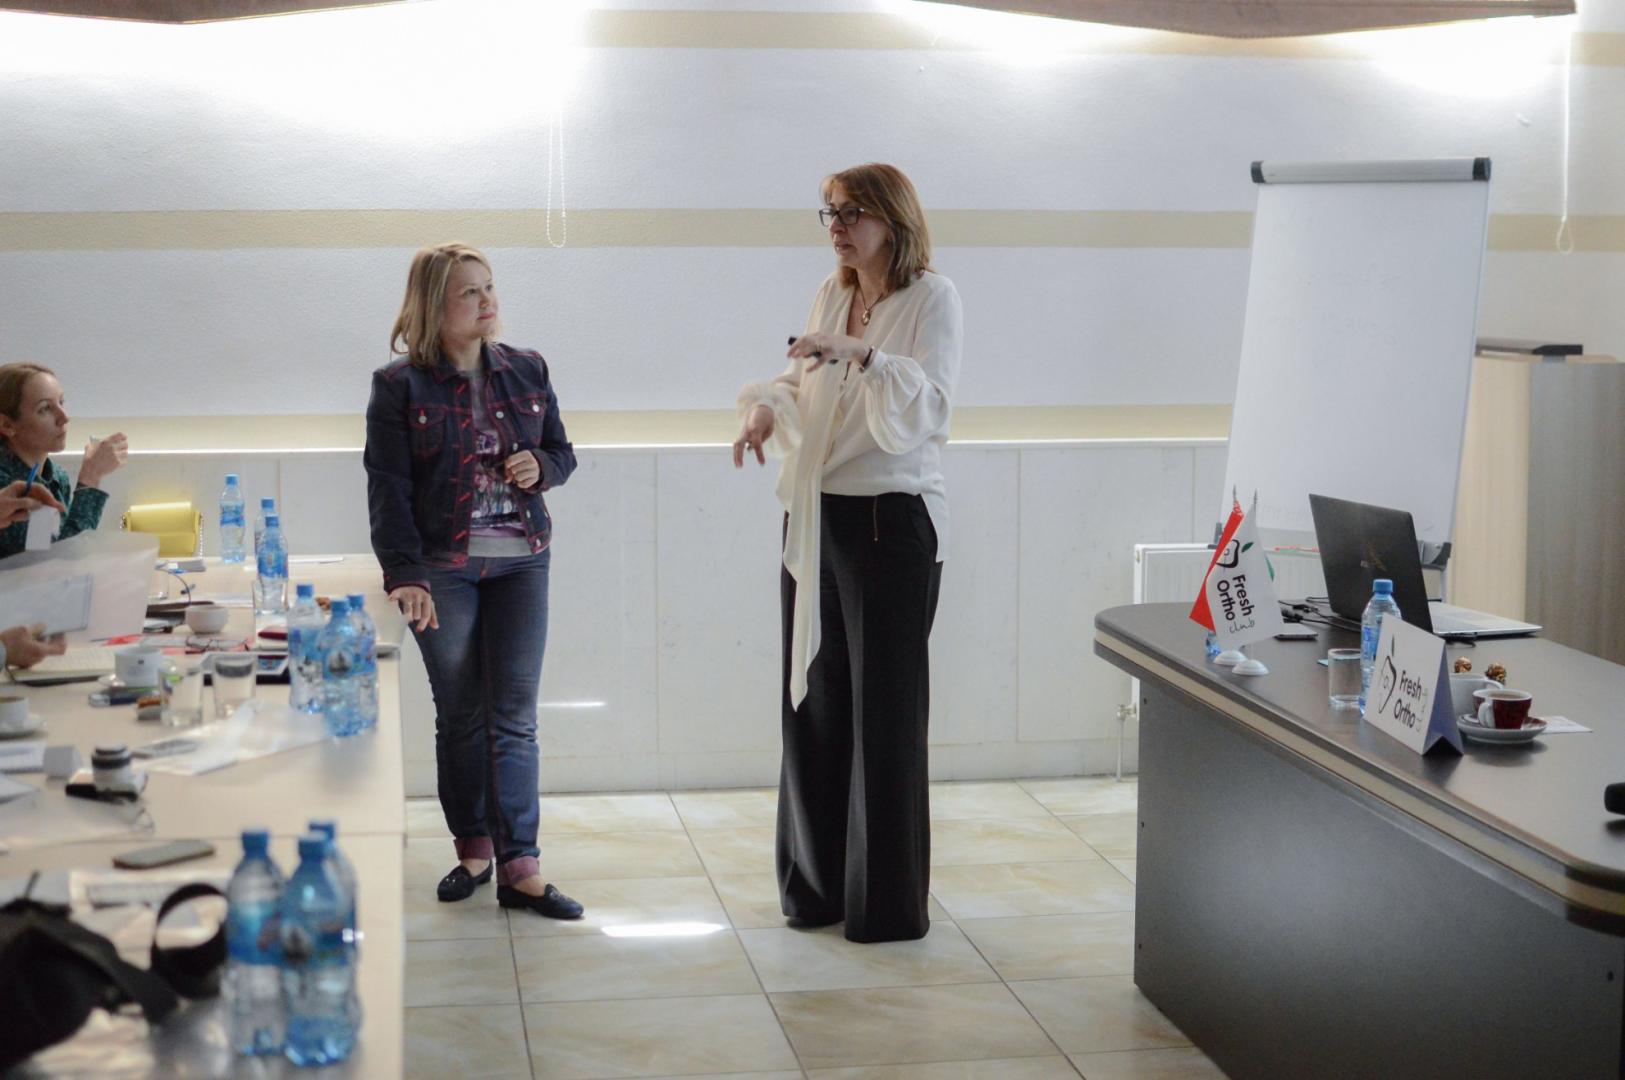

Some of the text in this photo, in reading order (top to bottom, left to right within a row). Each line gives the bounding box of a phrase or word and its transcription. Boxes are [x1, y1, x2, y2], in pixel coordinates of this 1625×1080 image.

[1217, 580, 1236, 621] Ortho
[1232, 574, 1255, 617] Fresh
[1229, 618, 1256, 634] club
[1400, 670, 1422, 701] Fresh
[1393, 699, 1416, 729] Ortho
